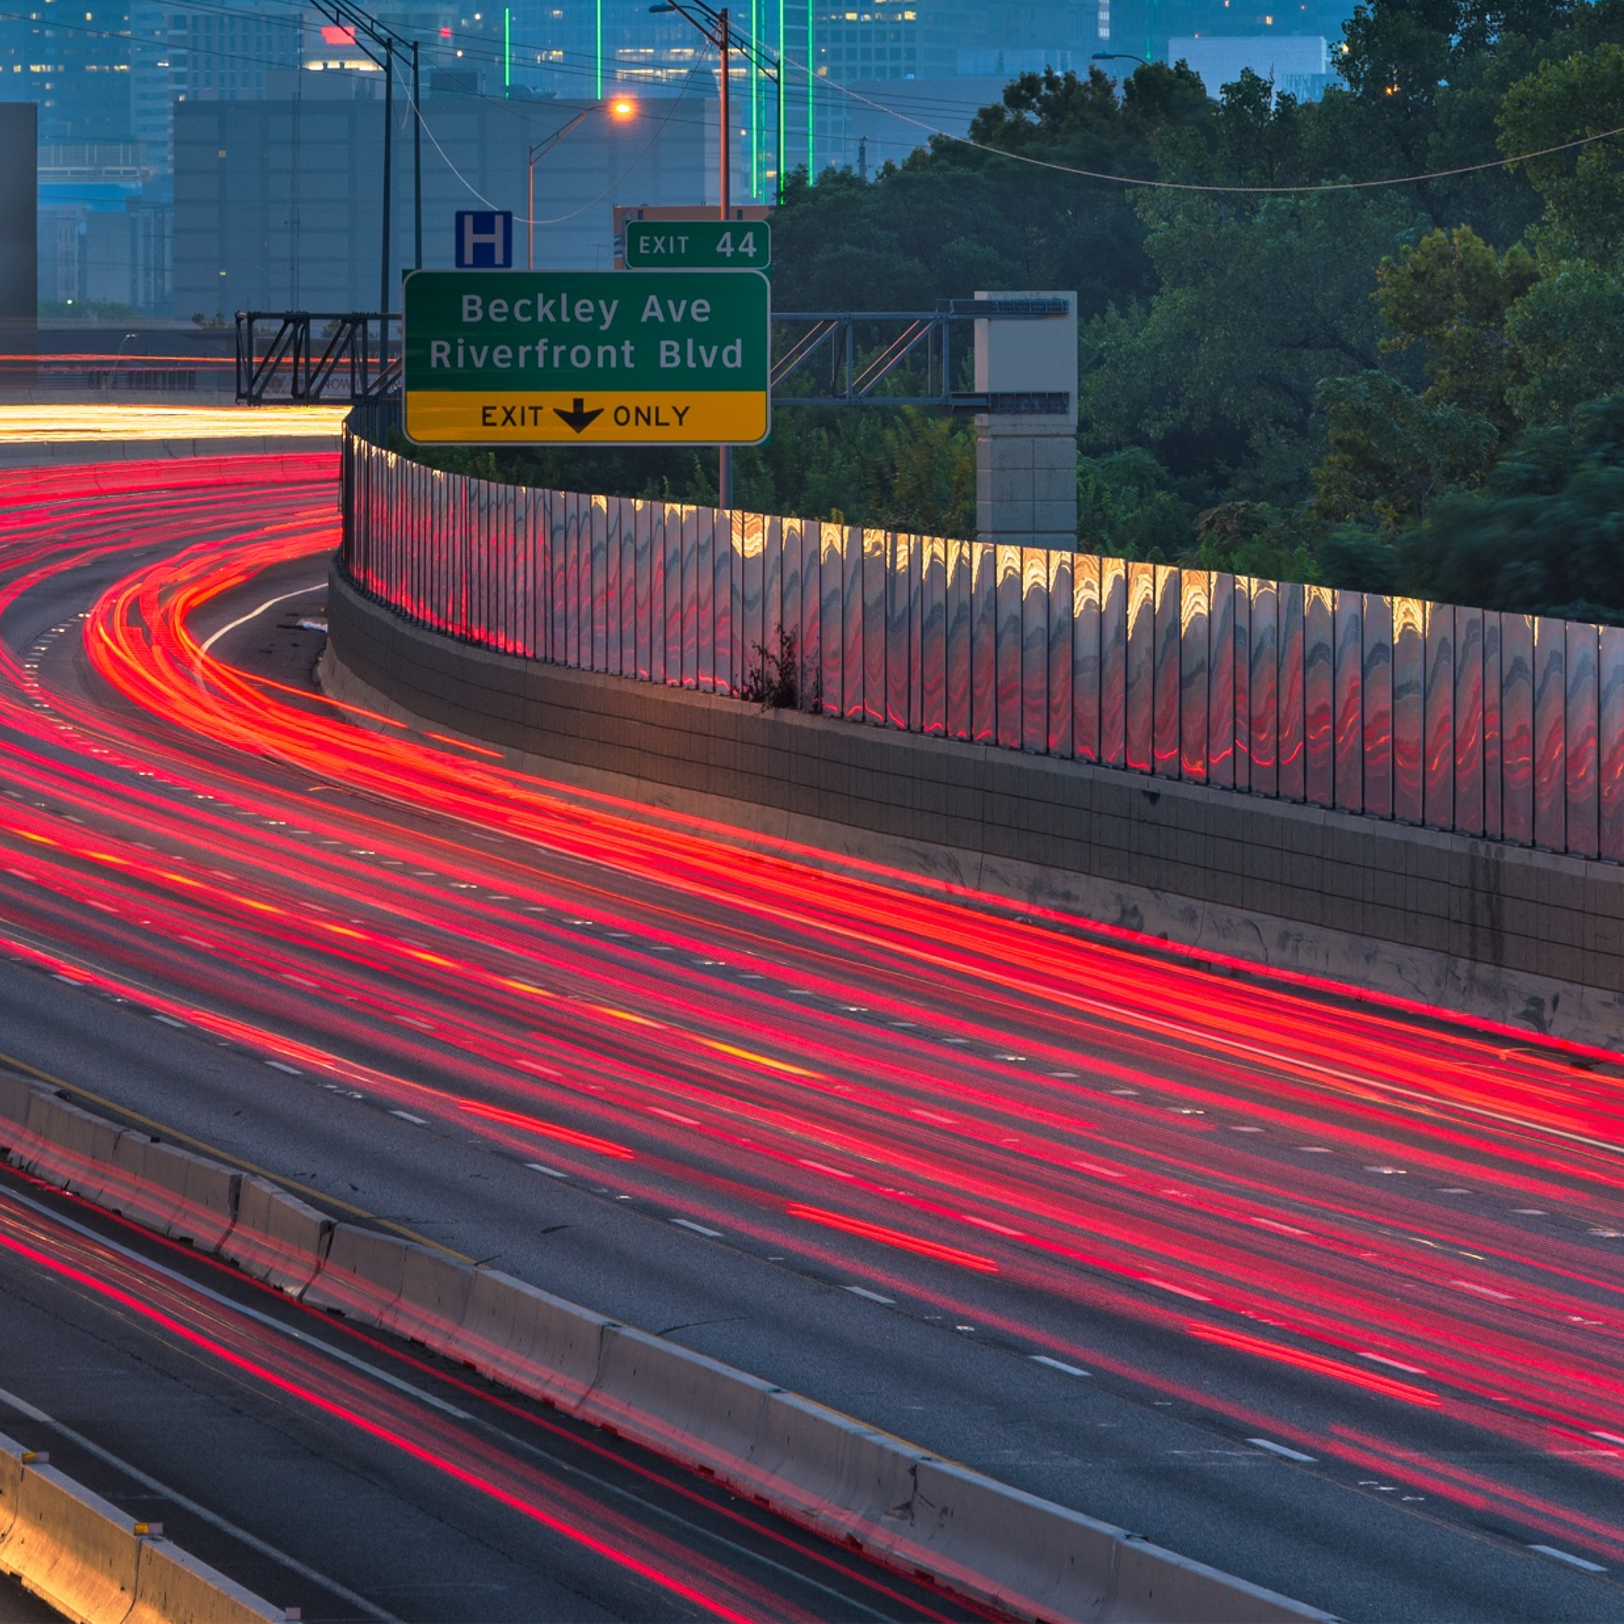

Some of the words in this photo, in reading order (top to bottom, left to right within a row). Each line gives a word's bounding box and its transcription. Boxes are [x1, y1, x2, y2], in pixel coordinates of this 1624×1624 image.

[463, 214, 504, 265] H
[639, 236, 689, 254] EXIT
[715, 231, 757, 257] 44
[461, 293, 619, 330] Beckley
[640, 295, 711, 322] Ave
[430, 338, 635, 368] Riverfront
[659, 338, 743, 368] Blvd
[481, 406, 543, 427] EXIT
[613, 406, 690, 427] ONLY
